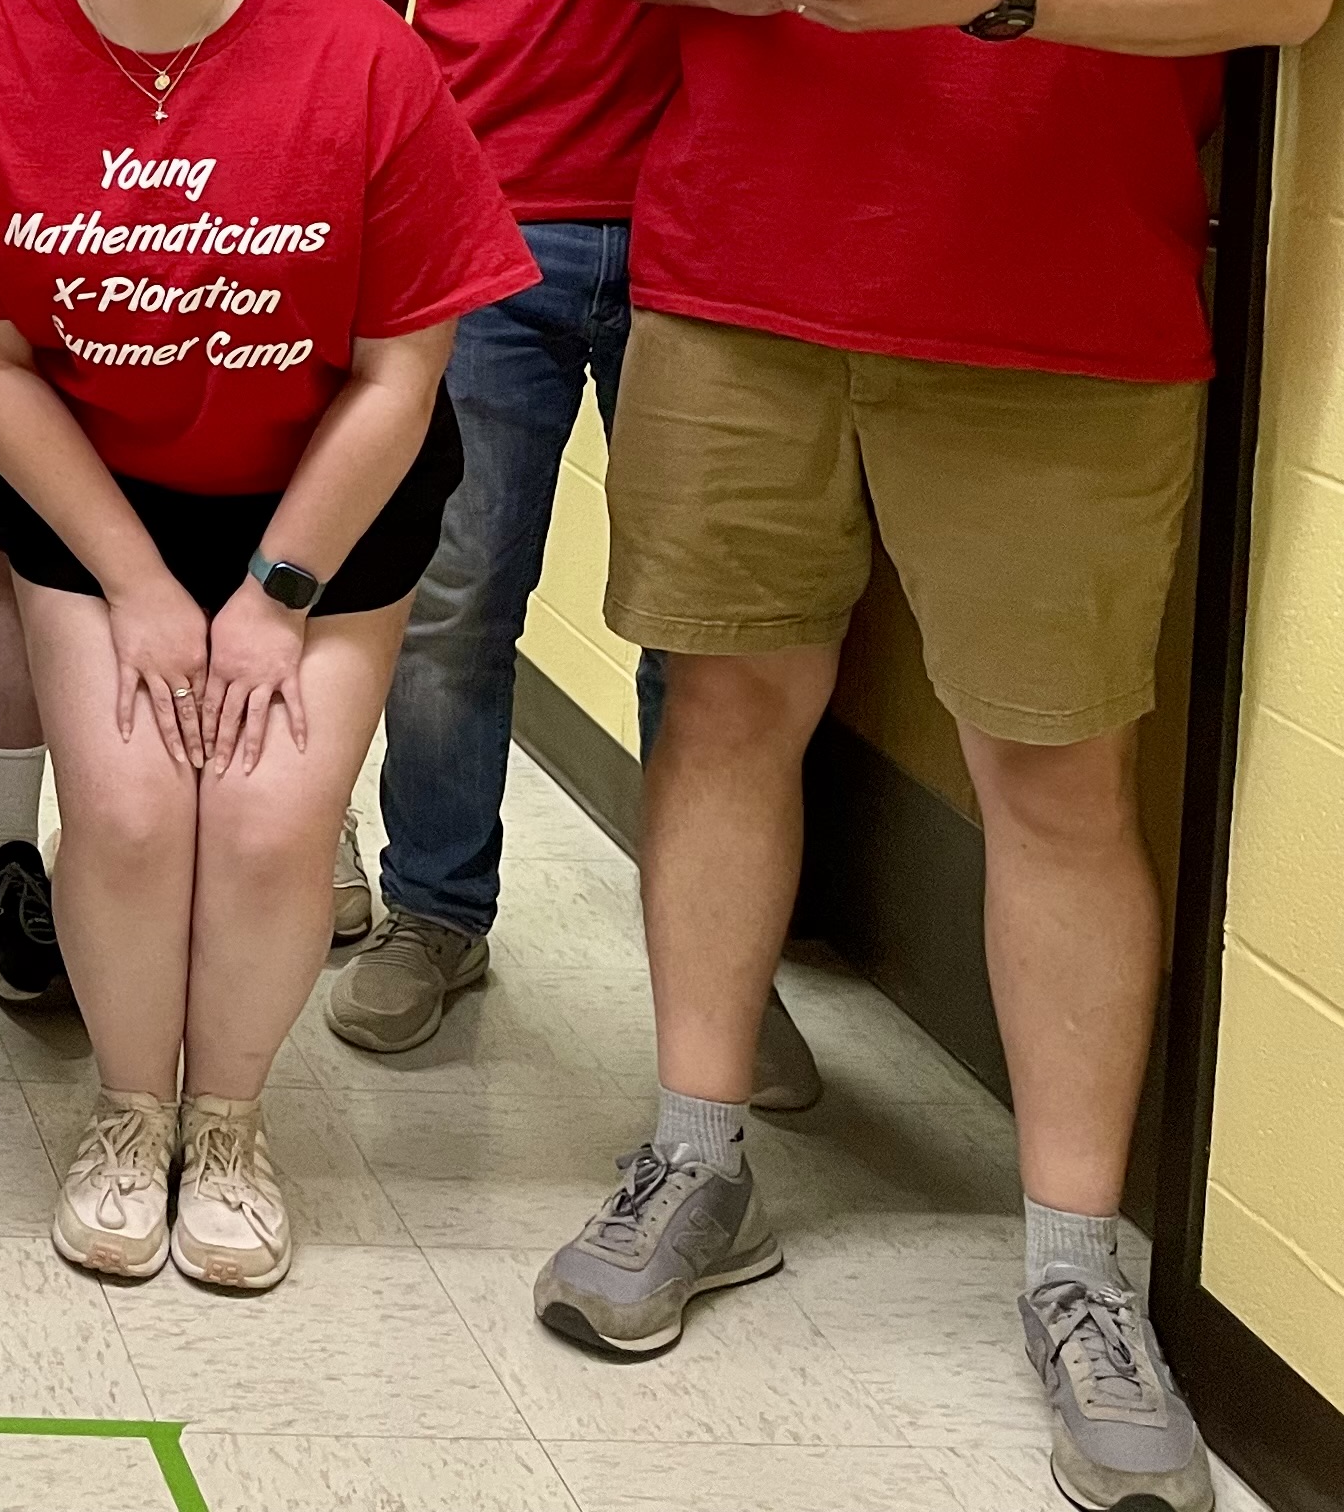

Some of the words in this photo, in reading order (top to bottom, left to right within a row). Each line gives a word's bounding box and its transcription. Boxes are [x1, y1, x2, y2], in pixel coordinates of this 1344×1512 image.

[100, 147, 217, 201] Young
[4, 210, 331, 255] Mathematicians
[52, 275, 282, 316] X-Ploration
[51, 315, 200, 366] Summer
[206, 330, 313, 372] Camp
